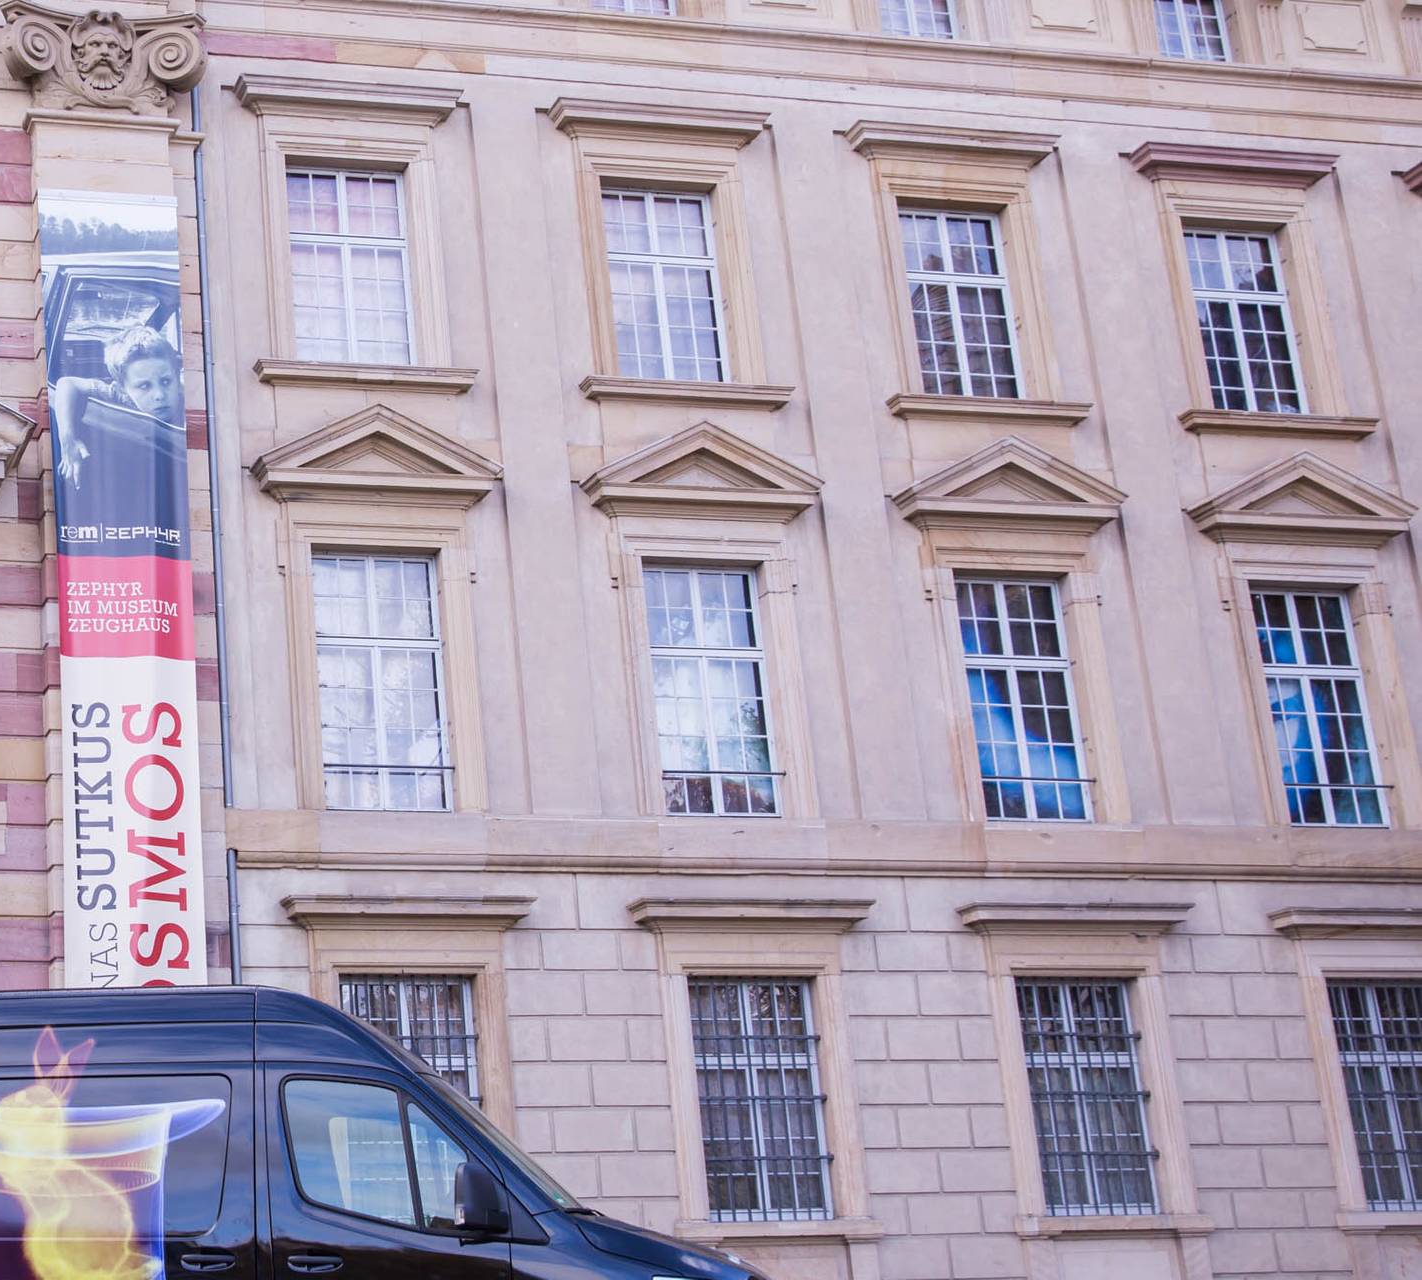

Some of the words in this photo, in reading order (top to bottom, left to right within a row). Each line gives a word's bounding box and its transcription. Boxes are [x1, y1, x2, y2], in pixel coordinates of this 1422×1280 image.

[60, 526, 98, 539] rem
[66, 581, 144, 597] ZEPHYR
[67, 600, 91, 615] IM
[97, 599, 179, 617] MUSEUM
[68, 617, 171, 634] ZEUGHAUS
[71, 701, 117, 911] SUTKUS
[121, 701, 191, 988] SMOS
